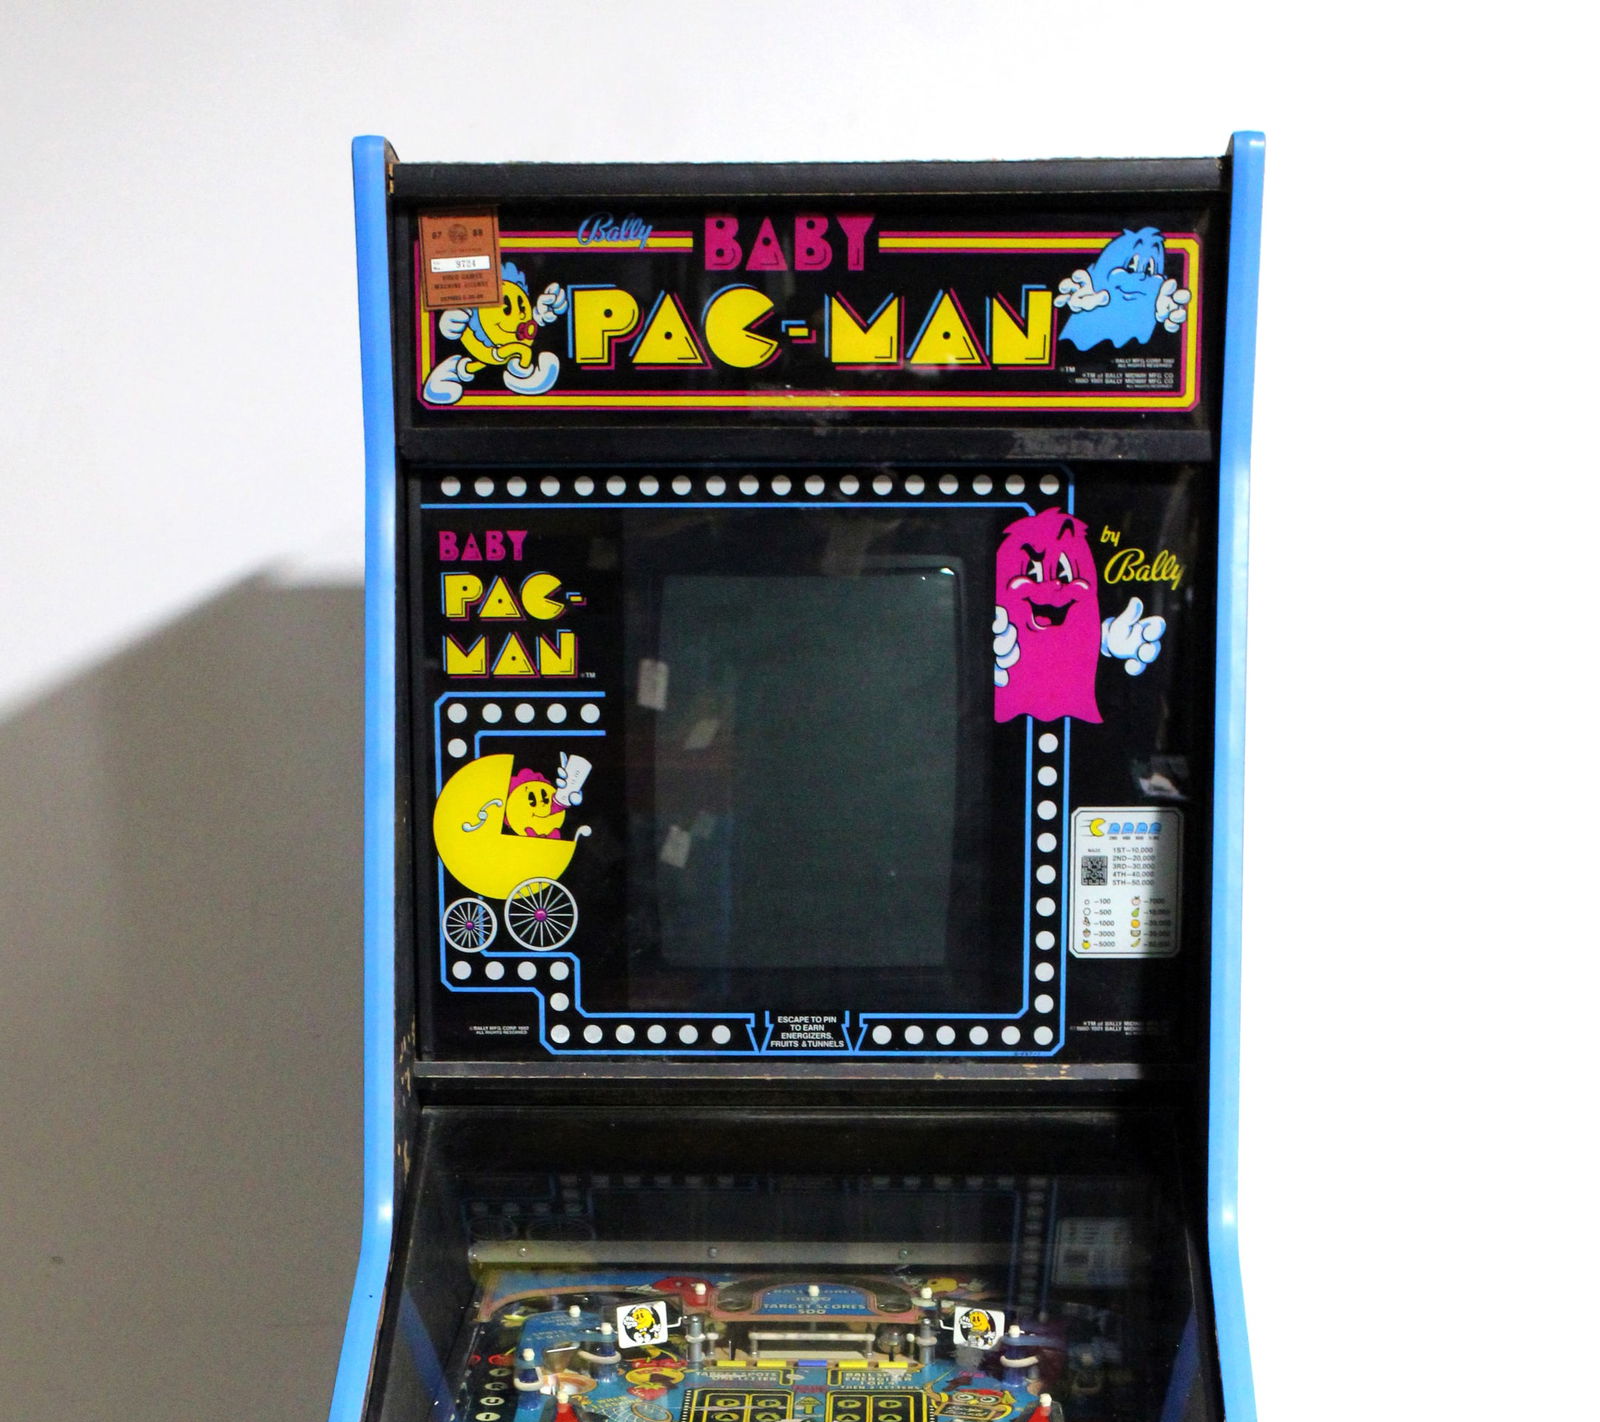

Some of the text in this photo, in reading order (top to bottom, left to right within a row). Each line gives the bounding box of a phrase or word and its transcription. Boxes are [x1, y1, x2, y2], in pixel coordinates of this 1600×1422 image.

[577, 212, 653, 249] Bally
[705, 214, 875, 271] BABY
[567, 284, 1057, 369] PAC-MAN
[438, 530, 528, 561] BABY
[1100, 525, 1121, 548] by
[1103, 548, 1184, 591] Bally
[440, 570, 587, 621] PAC-
[441, 629, 578, 679] MAN
[770, 1040, 799, 1048] FRUITS
